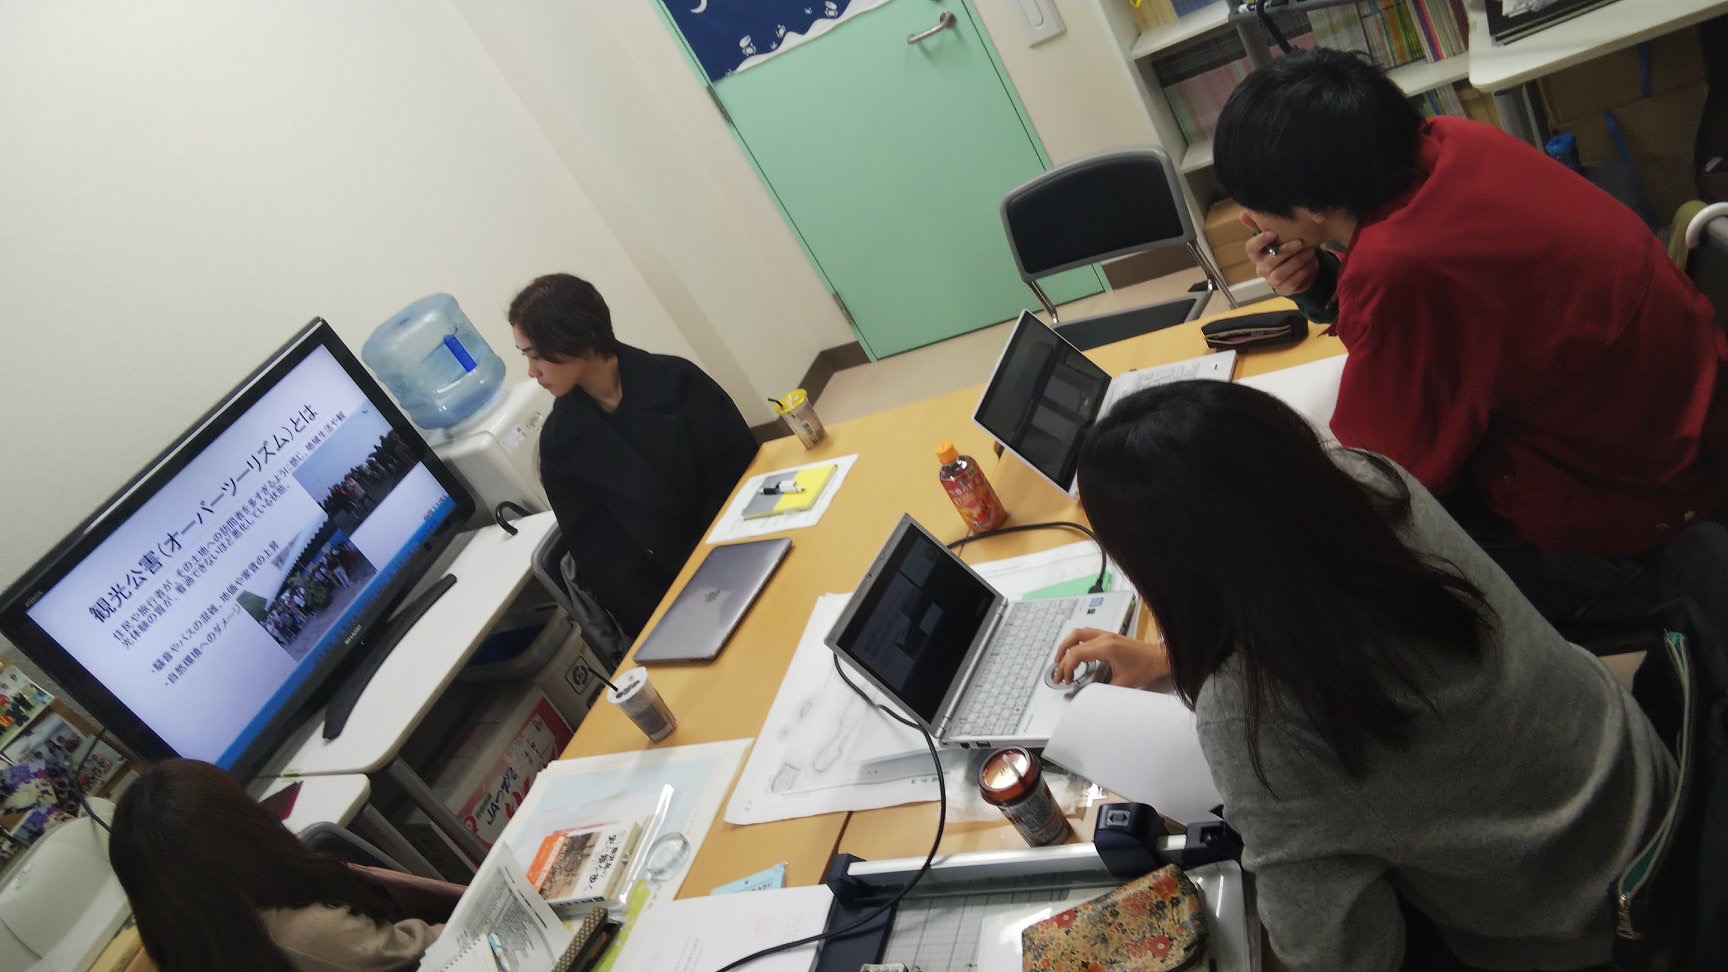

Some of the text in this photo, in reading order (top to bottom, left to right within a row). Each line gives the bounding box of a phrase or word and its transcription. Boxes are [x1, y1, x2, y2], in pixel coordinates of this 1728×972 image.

[88, 404, 318, 623] 観光公害(オーバーツーリズム)とは
